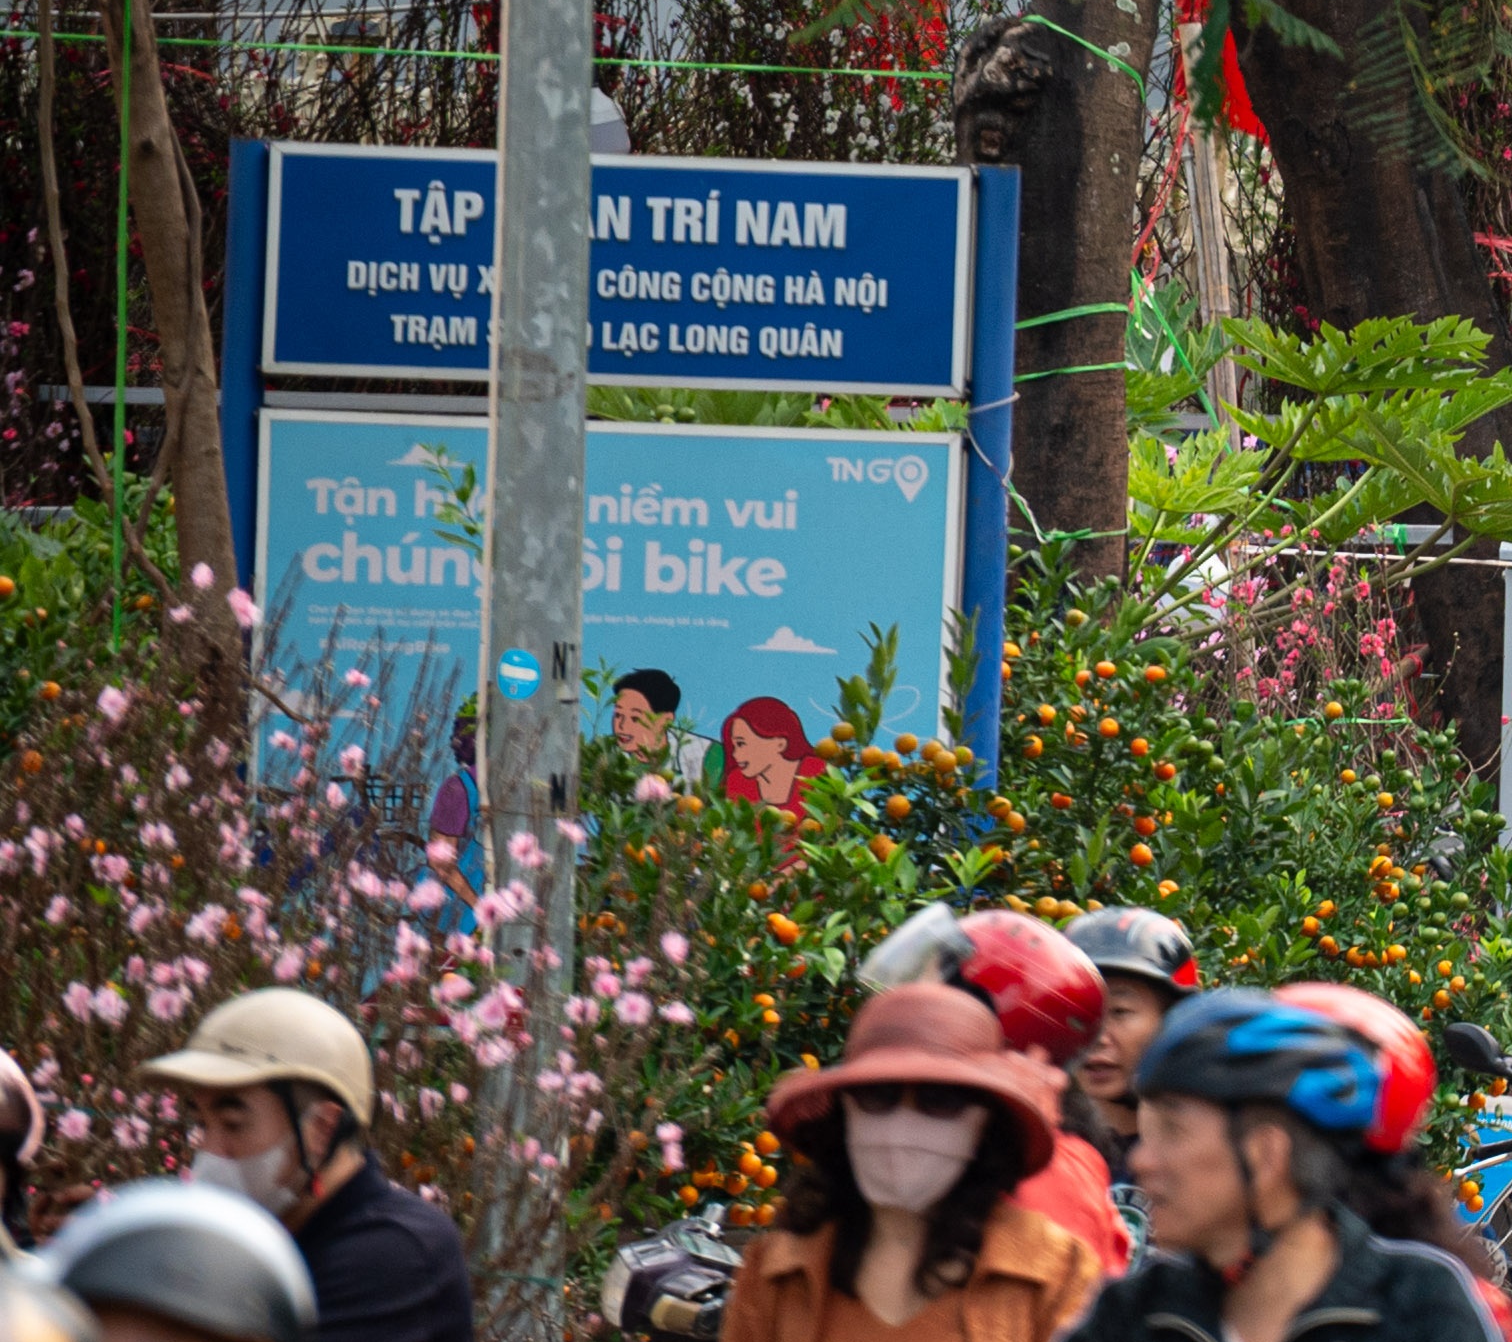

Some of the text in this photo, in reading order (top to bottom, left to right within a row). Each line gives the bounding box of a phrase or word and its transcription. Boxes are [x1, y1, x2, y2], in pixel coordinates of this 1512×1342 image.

[394, 180, 484, 244] TẬP
[646, 189, 720, 244] TRÍ
[735, 200, 847, 249] NAM
[347, 260, 419, 296] DỊCH
[429, 263, 468, 299] VỤ
[597, 264, 682, 300] CÔNG
[691, 267, 776, 309] CỘNG
[784, 270, 825, 306] HÀ
[835, 272, 888, 314] NỘI
[390, 314, 477, 351] TRẠM
[602, 322, 660, 357] LẠC
[669, 325, 749, 355] LONG
[759, 323, 843, 359] QUÂN
[306, 477, 397, 525] Tận
[588, 484, 709, 527] niềm
[725, 489, 799, 531] vui
[645, 539, 787, 598] bike
